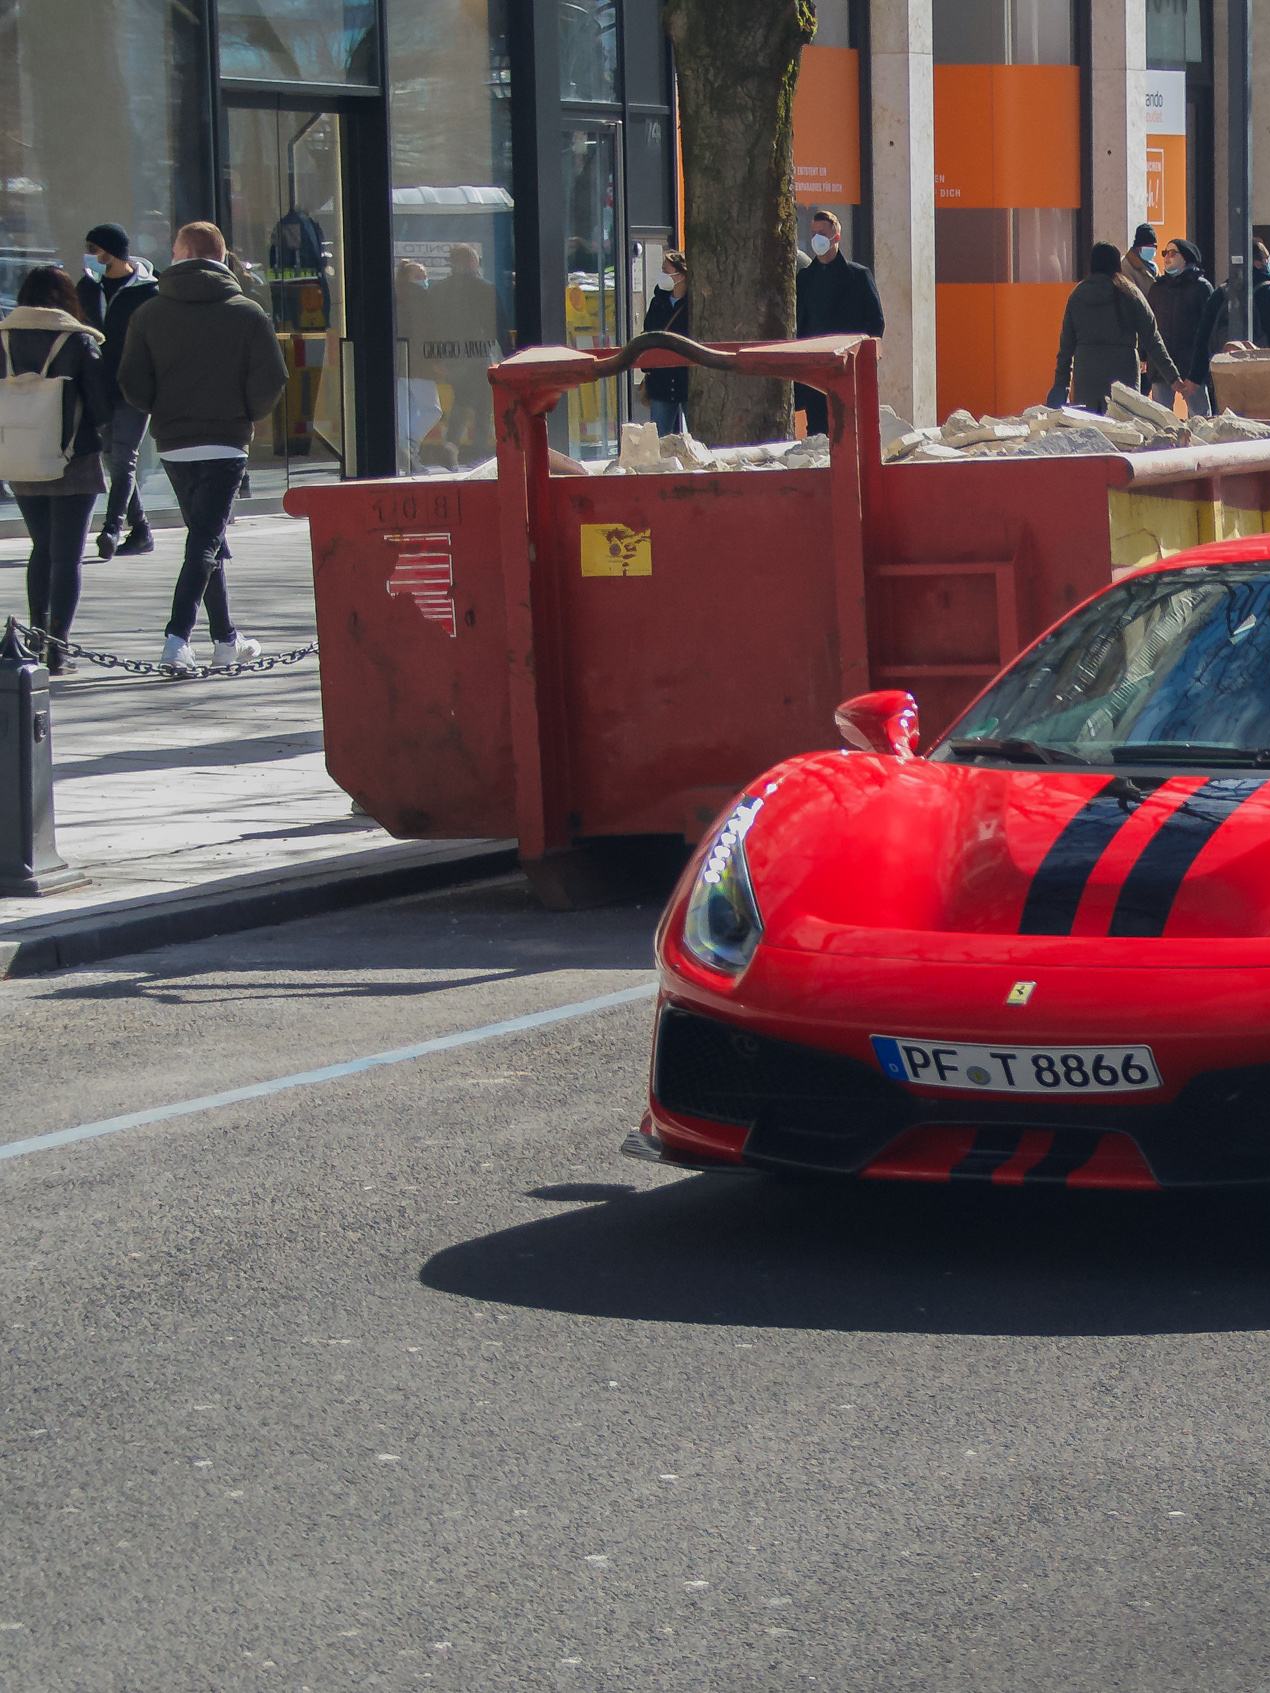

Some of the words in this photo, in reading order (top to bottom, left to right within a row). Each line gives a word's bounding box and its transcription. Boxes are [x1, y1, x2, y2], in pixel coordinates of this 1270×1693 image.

[1146, 90, 1163, 107] ando
[940, 189, 961, 198] DICH
[423, 341, 461, 360] GIORGIO
[464, 341, 496, 358] ARMAN
[901, 1045, 959, 1081] PF
[989, 1052, 1017, 1086] T
[1031, 1053, 1149, 1087] 8866
